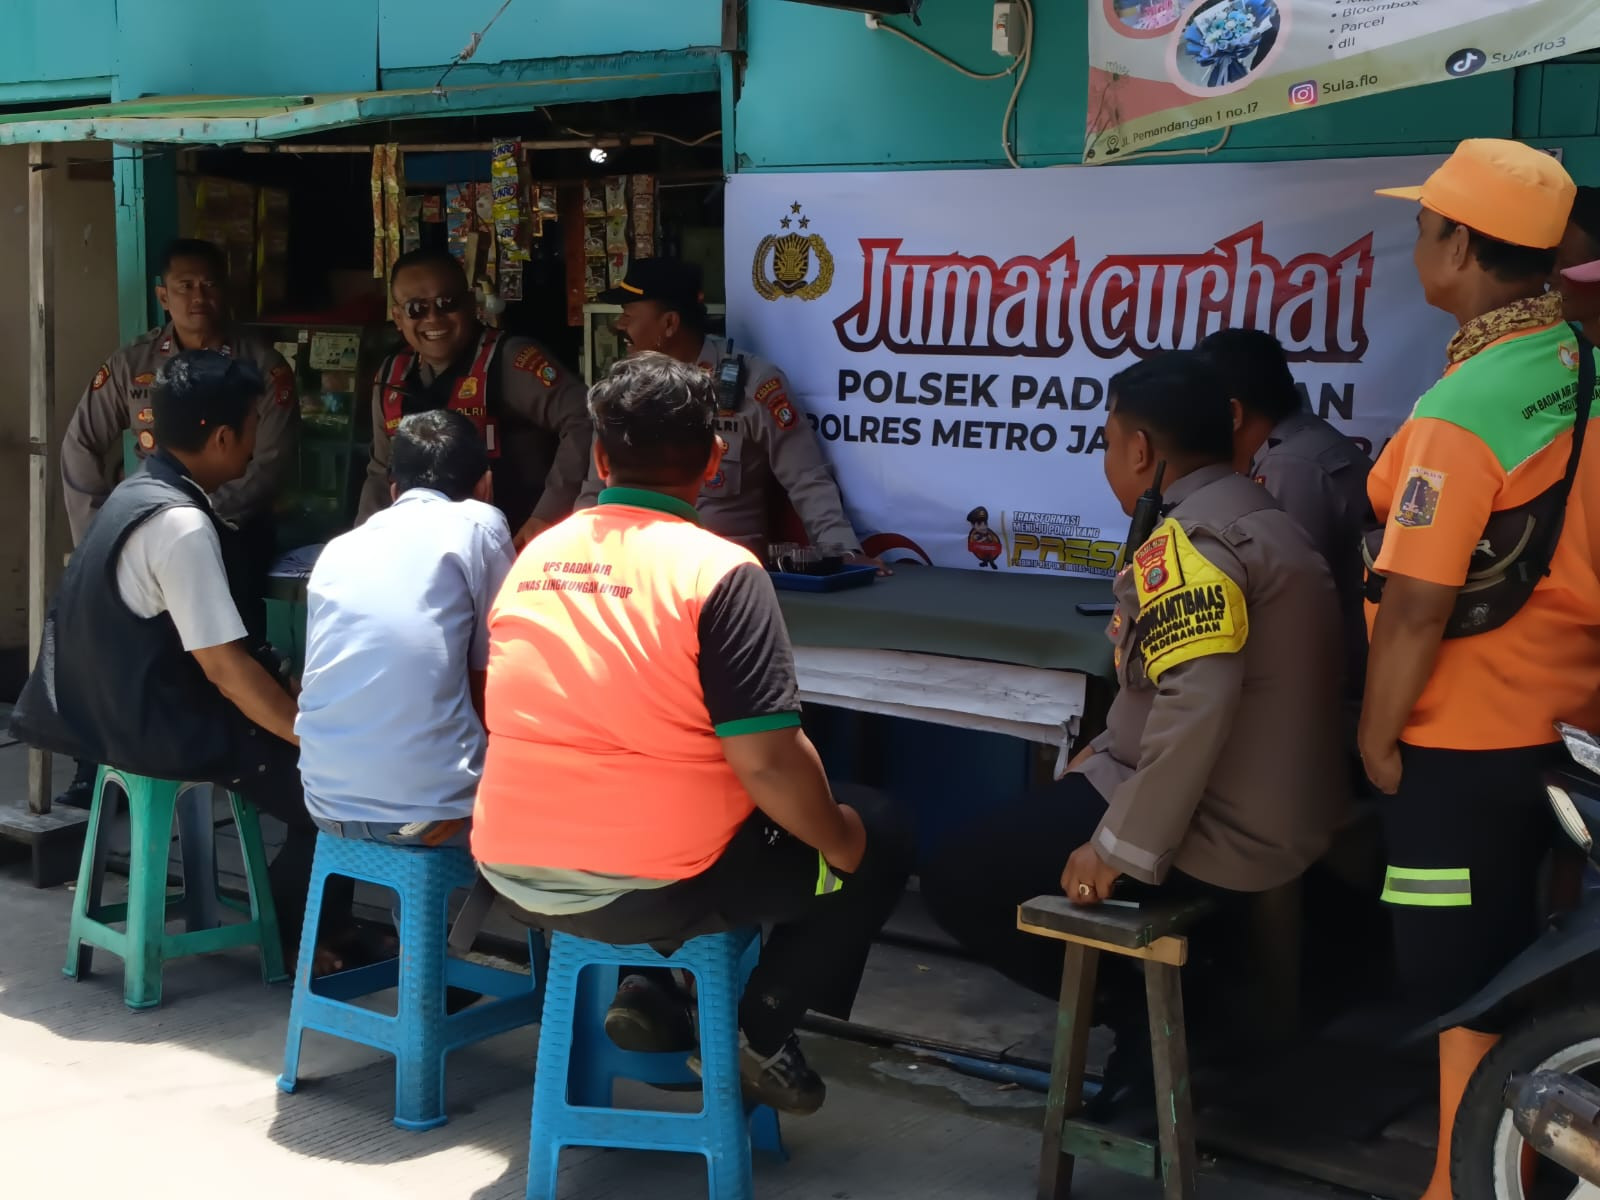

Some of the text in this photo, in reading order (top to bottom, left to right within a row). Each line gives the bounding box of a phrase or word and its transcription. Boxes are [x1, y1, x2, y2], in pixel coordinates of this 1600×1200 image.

[1342, 0, 1420, 18] Bloombox
[1340, 16, 1385, 33] Parcel
[1338, 37, 1355, 49] dll
[1491, 36, 1566, 64] Sula.flo3
[1322, 74, 1378, 94] Sula.flo
[1133, 116, 1213, 143] Pemandangan
[1226, 101, 1259, 119] no.17
[832, 236, 1080, 358] Jumat
[838, 368, 999, 407] POLSEK
[1521, 402, 1538, 420] UPK
[1537, 391, 1561, 411] BADAN
[1561, 384, 1571, 399] AIR
[805, 412, 922, 446] POLRES
[931, 417, 1057, 452] METRO
[1013, 511, 1080, 525] TRANSFORMASI
[1012, 521, 1100, 538] MENUJU POLRI YANG
[562, 562, 592, 575] BADAN
[592, 562, 612, 576] AIR
[518, 578, 632, 599] DINAS LINGKUNGAN HIDUP
[1195, 610, 1224, 625] BARAT
